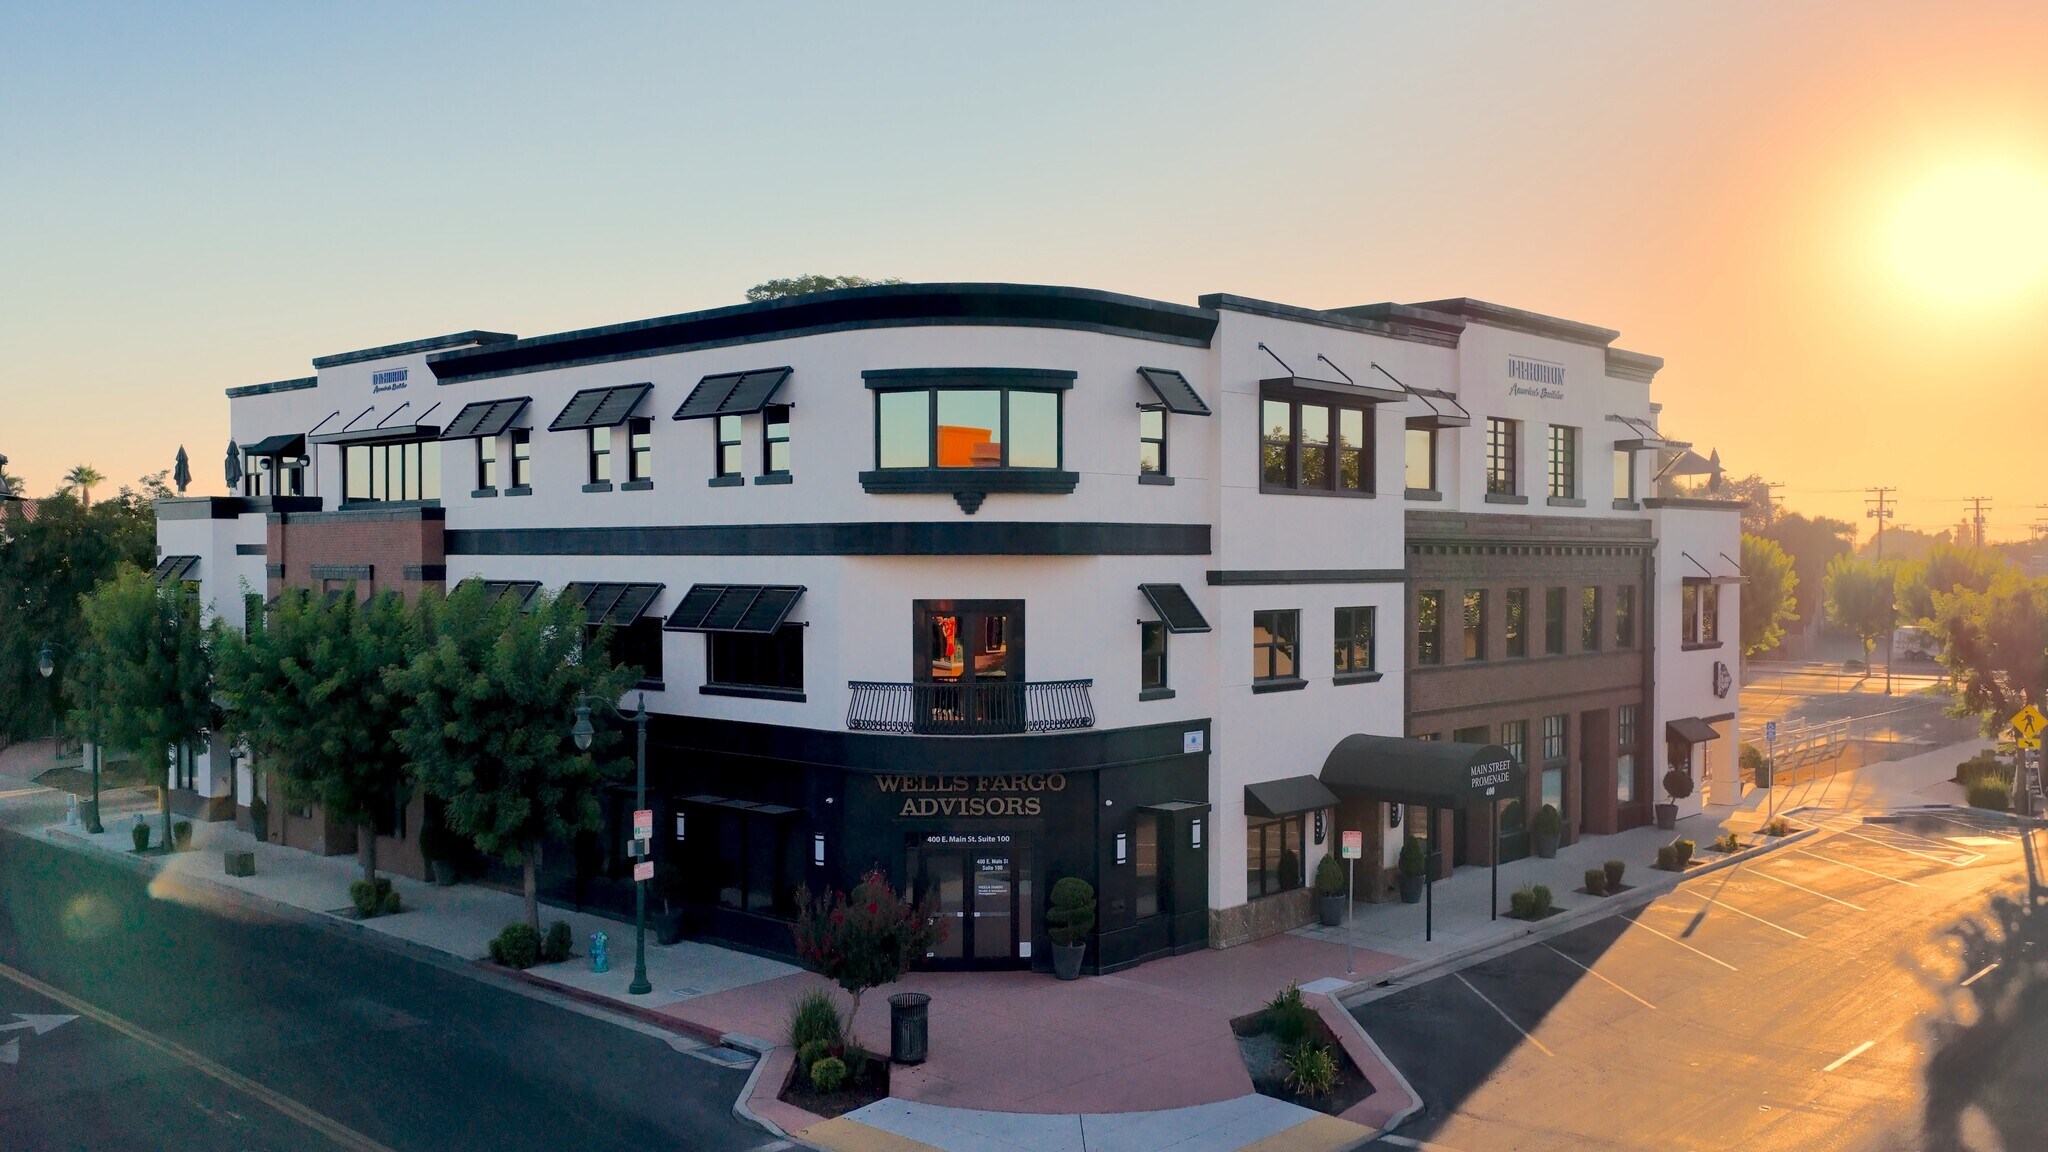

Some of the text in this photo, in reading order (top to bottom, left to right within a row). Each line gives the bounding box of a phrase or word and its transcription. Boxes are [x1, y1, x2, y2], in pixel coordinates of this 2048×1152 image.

[1470, 760, 1511, 776] MAIN STREET
[875, 772, 1067, 792] WELLS FARGO
[1471, 772, 1510, 788] PROMENADE
[1485, 786, 1495, 796] 400
[899, 797, 1041, 816] ADVISORS
[978, 835, 996, 843] Suite
